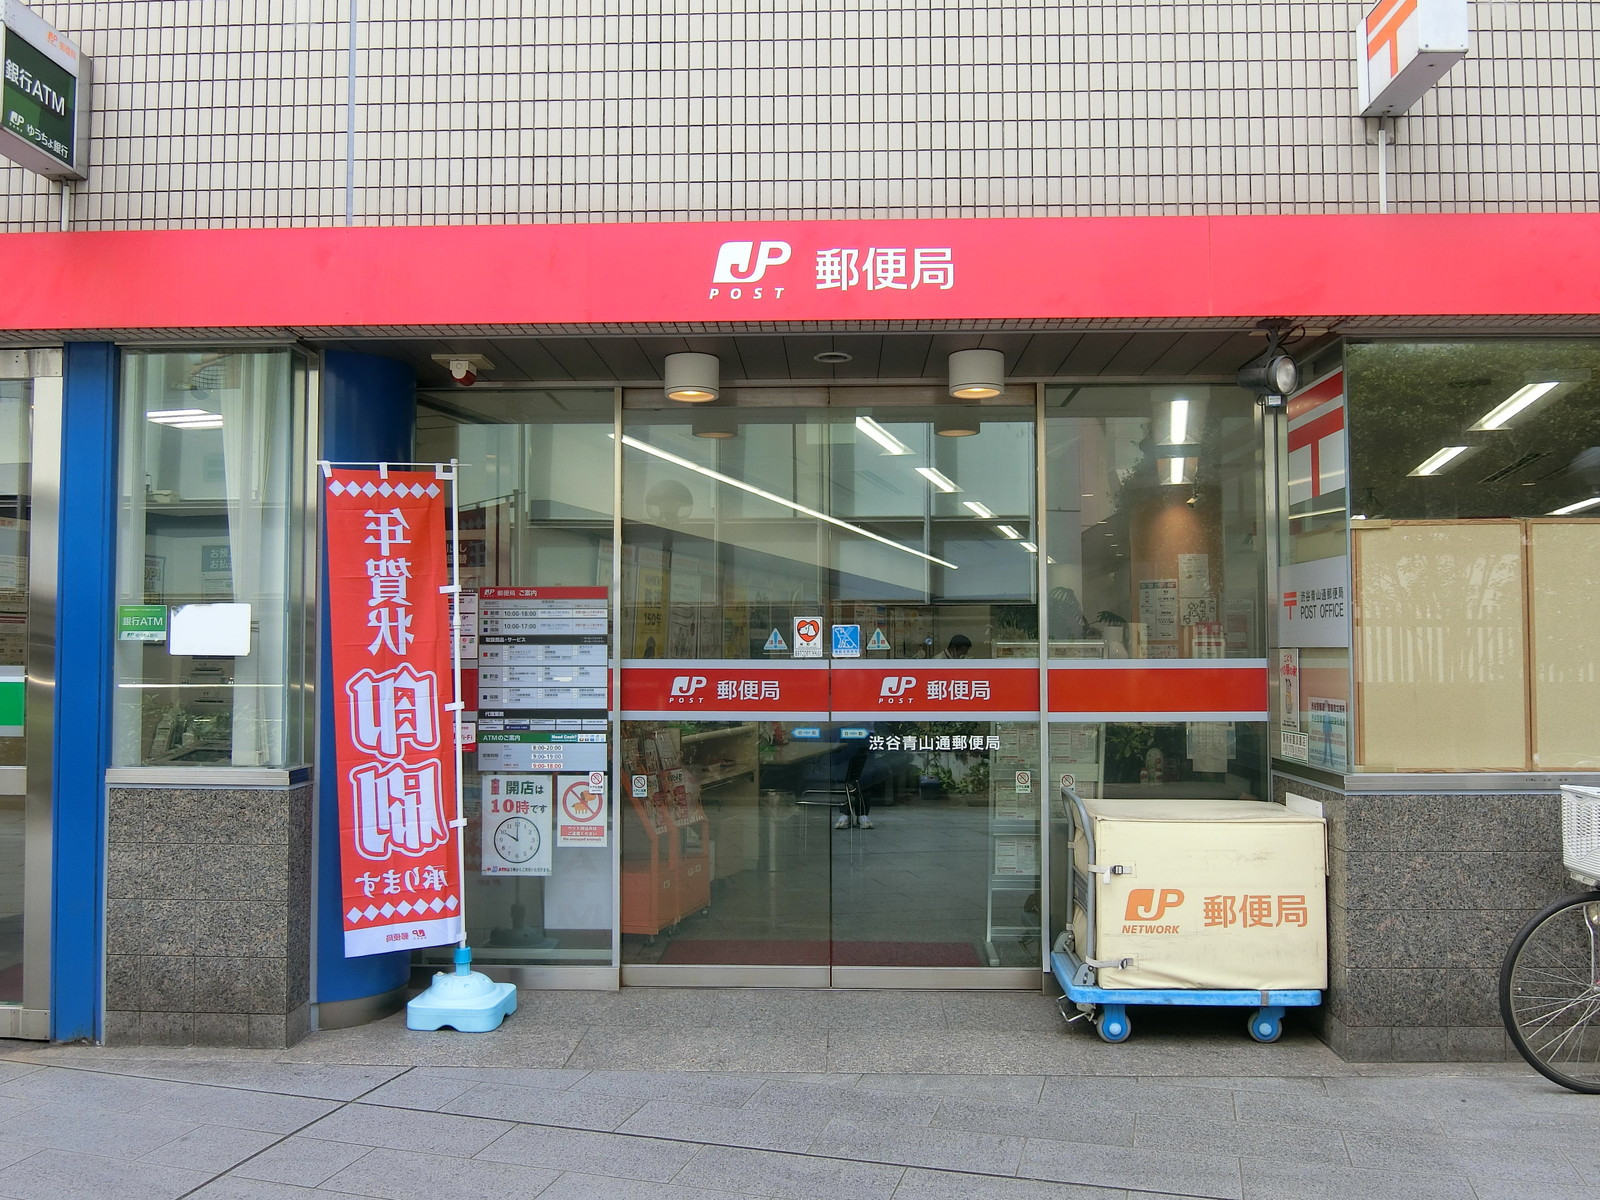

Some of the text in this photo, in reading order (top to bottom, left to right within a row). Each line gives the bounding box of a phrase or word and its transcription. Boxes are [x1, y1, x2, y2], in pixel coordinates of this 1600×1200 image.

[5, 58, 65, 117] 銀行ATM
[26, 122, 69, 159] ゆうちょ銀行
[815, 247, 955, 291] 郵便局
[708, 287, 785, 300] POST
[1300, 586, 1344, 602] 渋谷青山通郵便局
[1300, 602, 1344, 619] POST OFFICE
[122, 616, 163, 626] 銀行ATM
[716, 679, 780, 701] 郵便局
[926, 679, 991, 701] 郵便局
[482, 734, 521, 742] ATMのご案内
[868, 734, 1001, 751] 渋谷青山通郵便局
[505, 780, 544, 795] 開店は
[491, 798, 548, 815] 10時です
[1203, 894, 1308, 929] 郵便局
[1121, 924, 1180, 934] NETWORK
